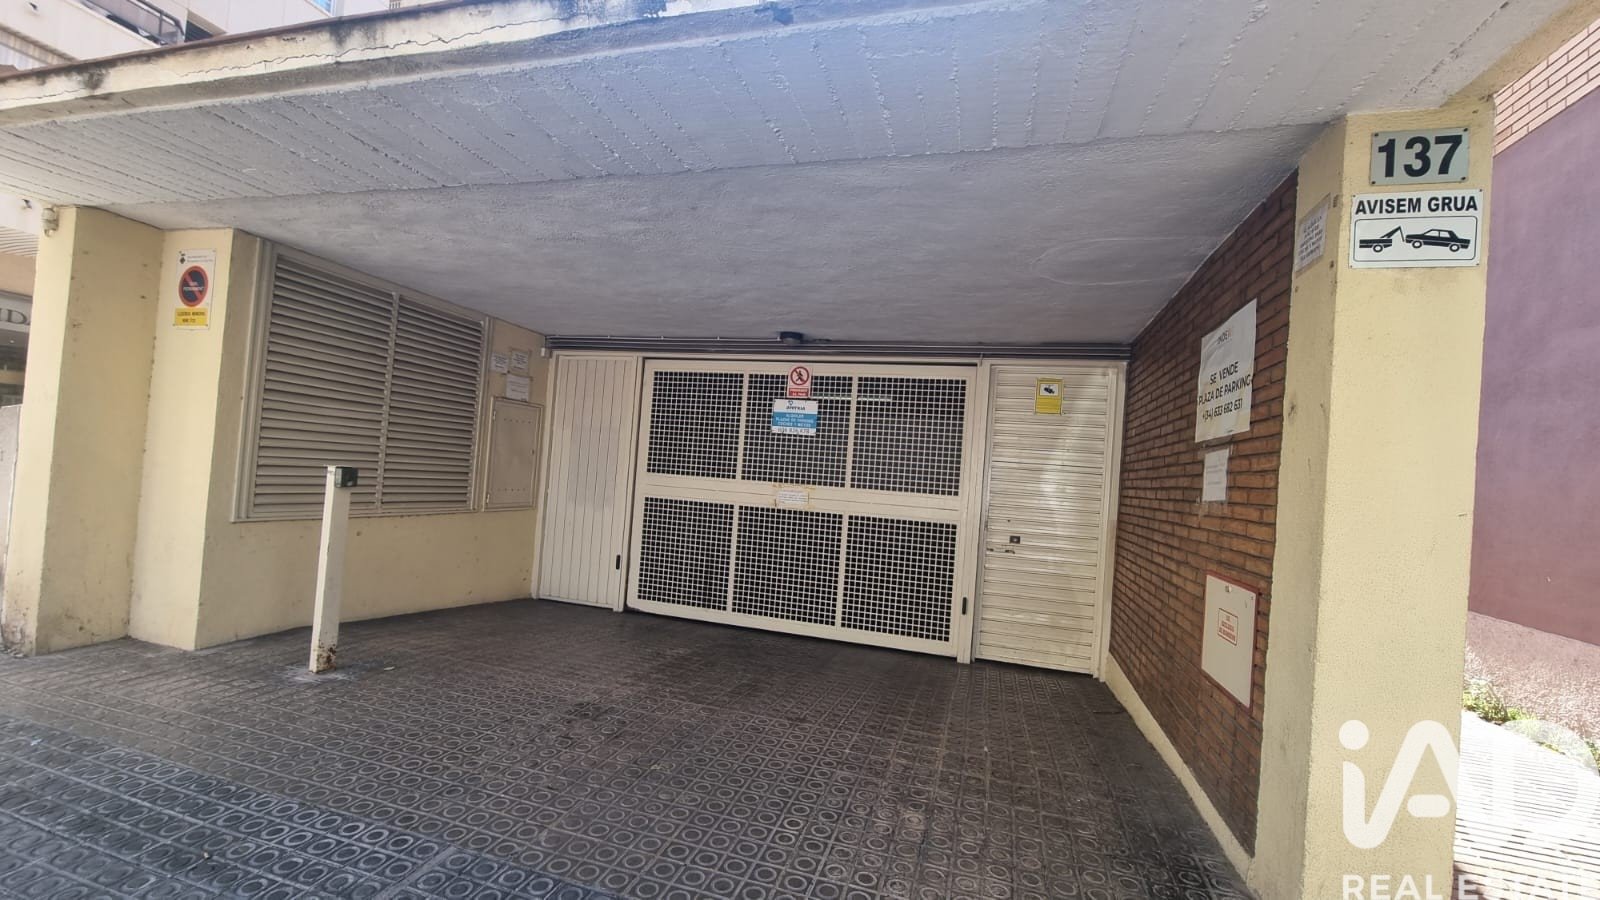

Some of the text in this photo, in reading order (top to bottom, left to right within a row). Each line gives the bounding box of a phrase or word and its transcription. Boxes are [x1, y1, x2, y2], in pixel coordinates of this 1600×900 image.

[1378, 134, 1463, 178] 137
[1355, 195, 1478, 215] AVISEM GRUA
[1209, 361, 1239, 385] SE VENDE
[1198, 374, 1252, 405] PLAZA DE PARKING
